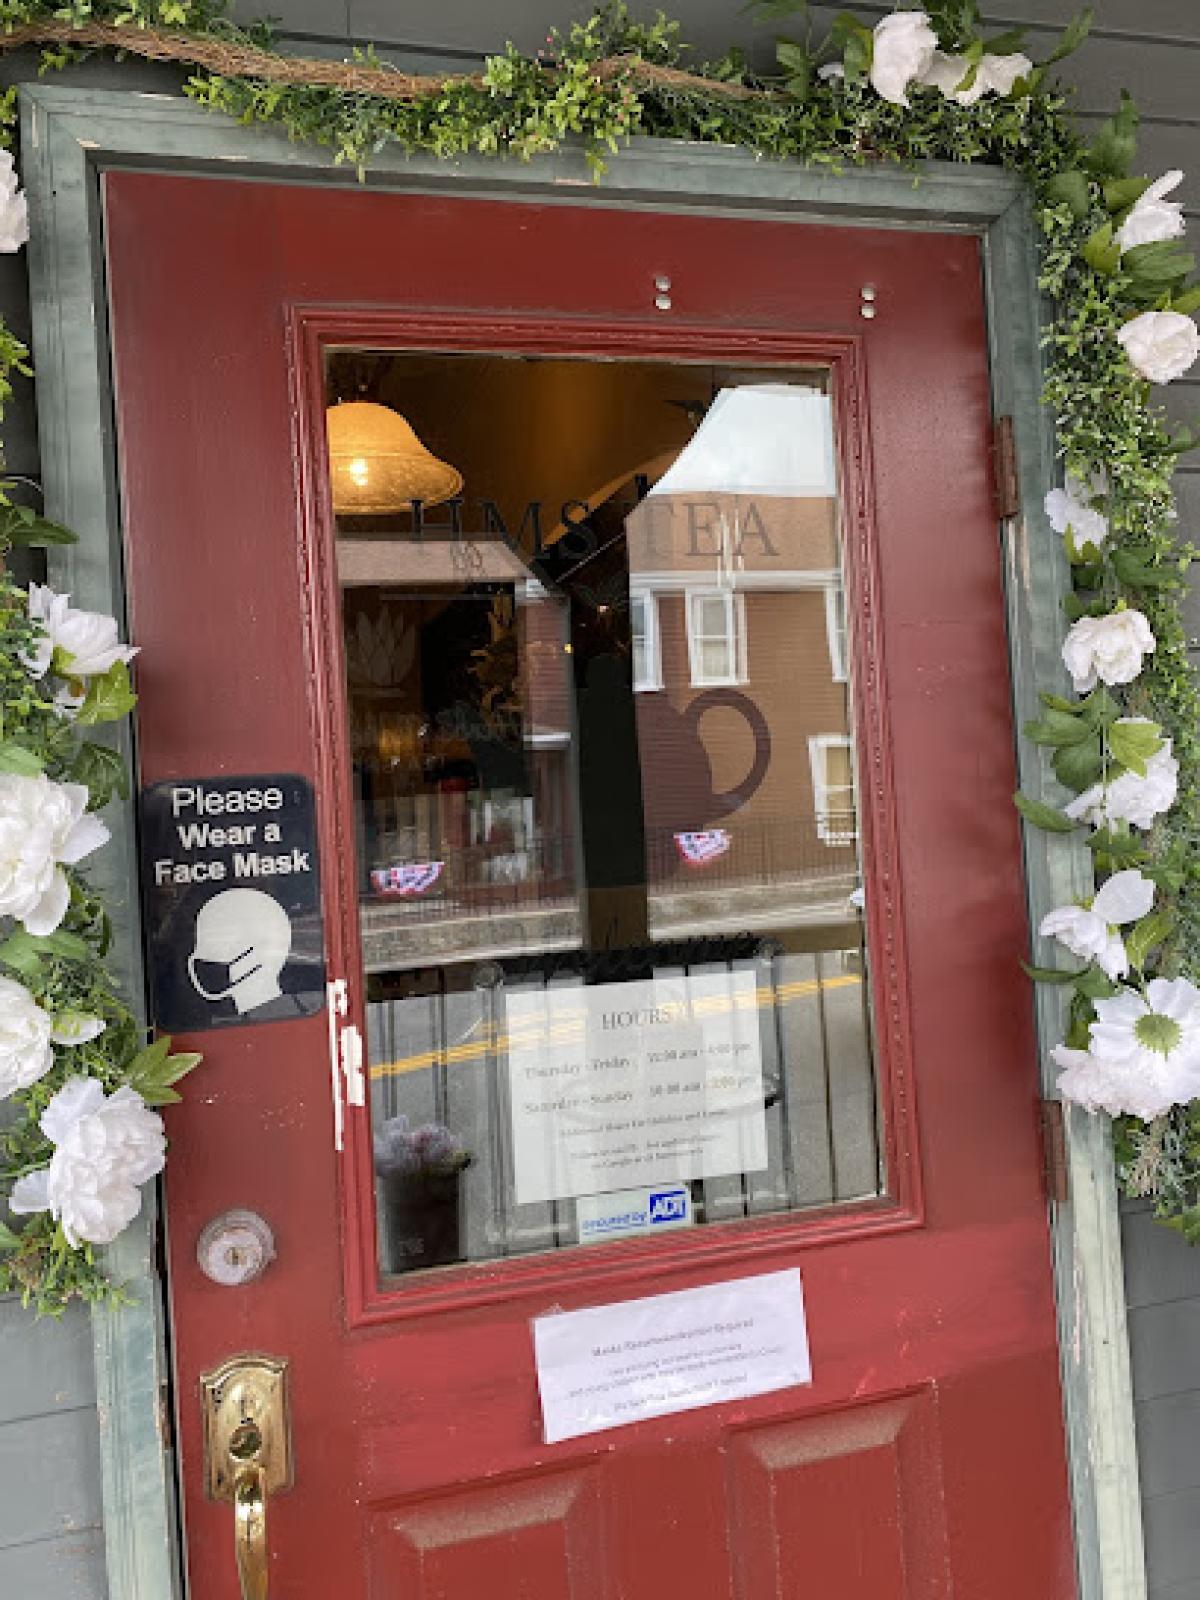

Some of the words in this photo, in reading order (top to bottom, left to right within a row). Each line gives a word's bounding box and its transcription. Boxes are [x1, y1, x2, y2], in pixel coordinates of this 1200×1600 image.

[628, 501, 780, 557] TEA
[172, 785, 284, 818] Please
[176, 823, 256, 850] Wear
[264, 823, 282, 842] a
[155, 858, 226, 886] Face
[232, 847, 311, 878] Mask
[602, 1009, 671, 1030] HOURS
